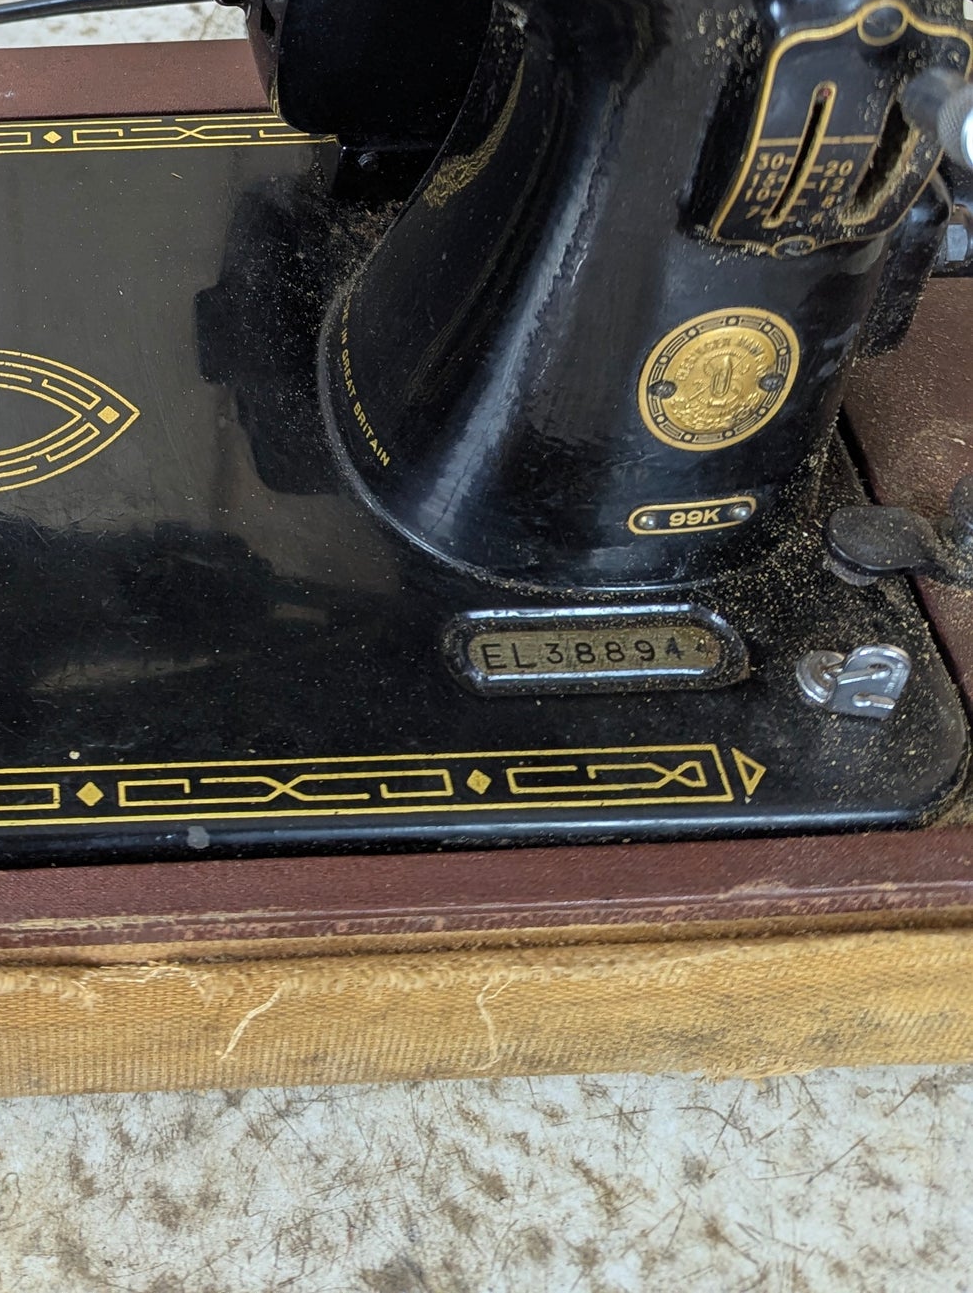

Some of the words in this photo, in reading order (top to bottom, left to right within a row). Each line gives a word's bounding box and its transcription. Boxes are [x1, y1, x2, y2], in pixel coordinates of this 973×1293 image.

[825, 159, 854, 177] 20
[744, 185, 771, 203] 10
[341, 348, 357, 398] GREAT
[353, 401, 391, 467] BRITAIN
[669, 505, 721, 527] 99K
